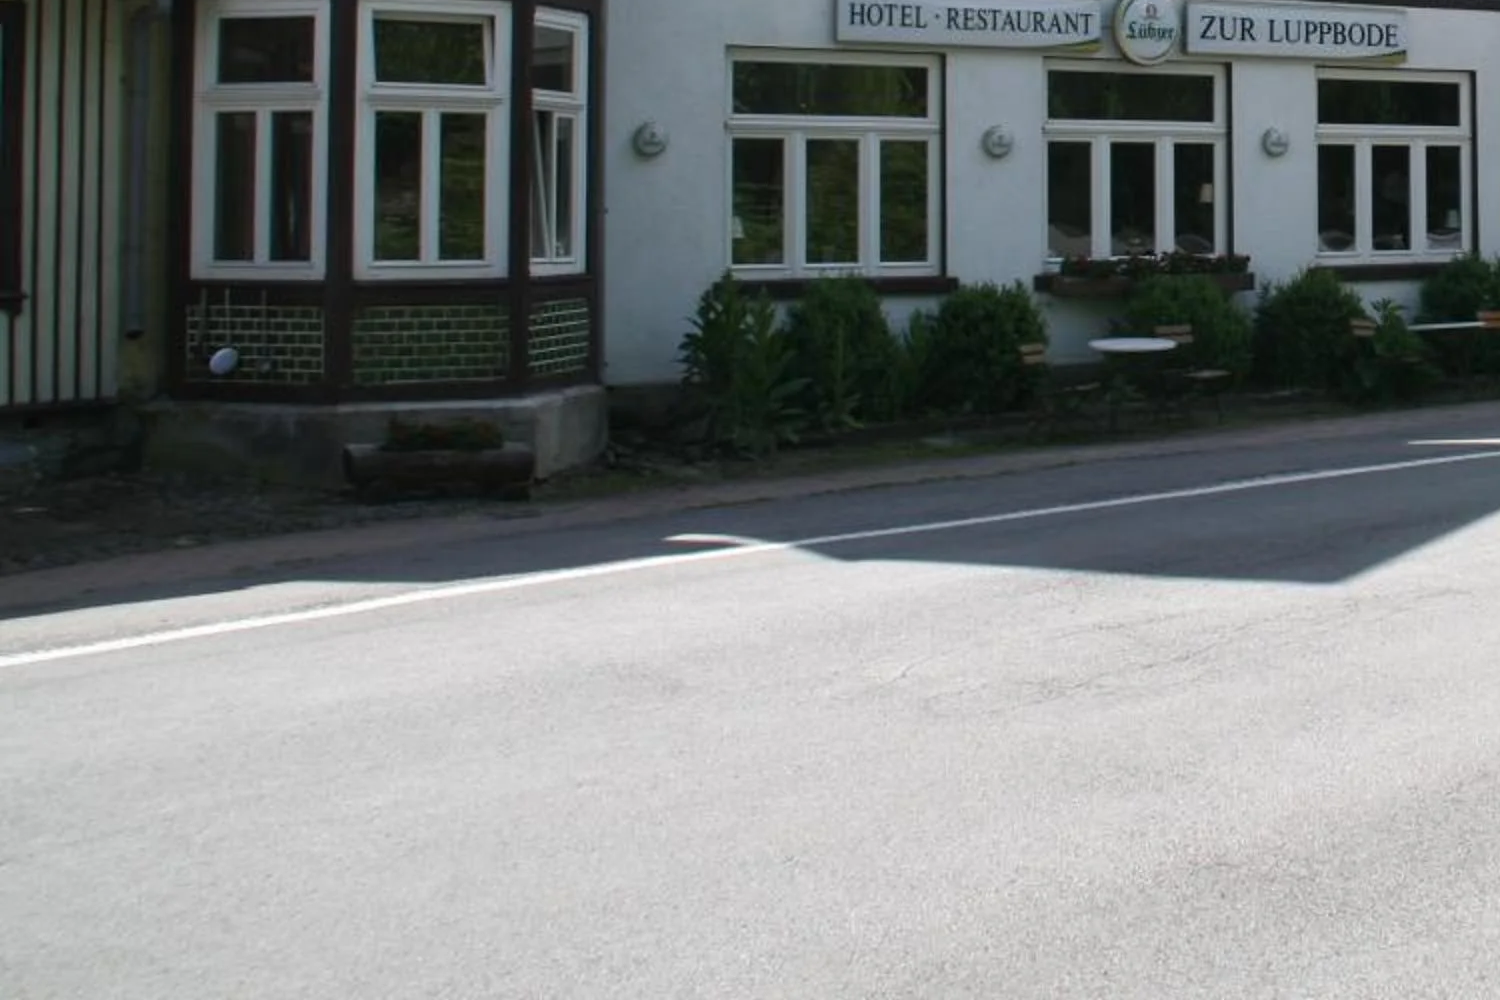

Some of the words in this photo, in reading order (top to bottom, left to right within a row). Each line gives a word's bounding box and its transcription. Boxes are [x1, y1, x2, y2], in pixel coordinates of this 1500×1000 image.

[849, 2, 928, 29] HOTEL
[946, 7, 1094, 35] RESTAURANT
[1200, 15, 1255, 42] ZUR
[1268, 18, 1399, 48] LUPPBODE
